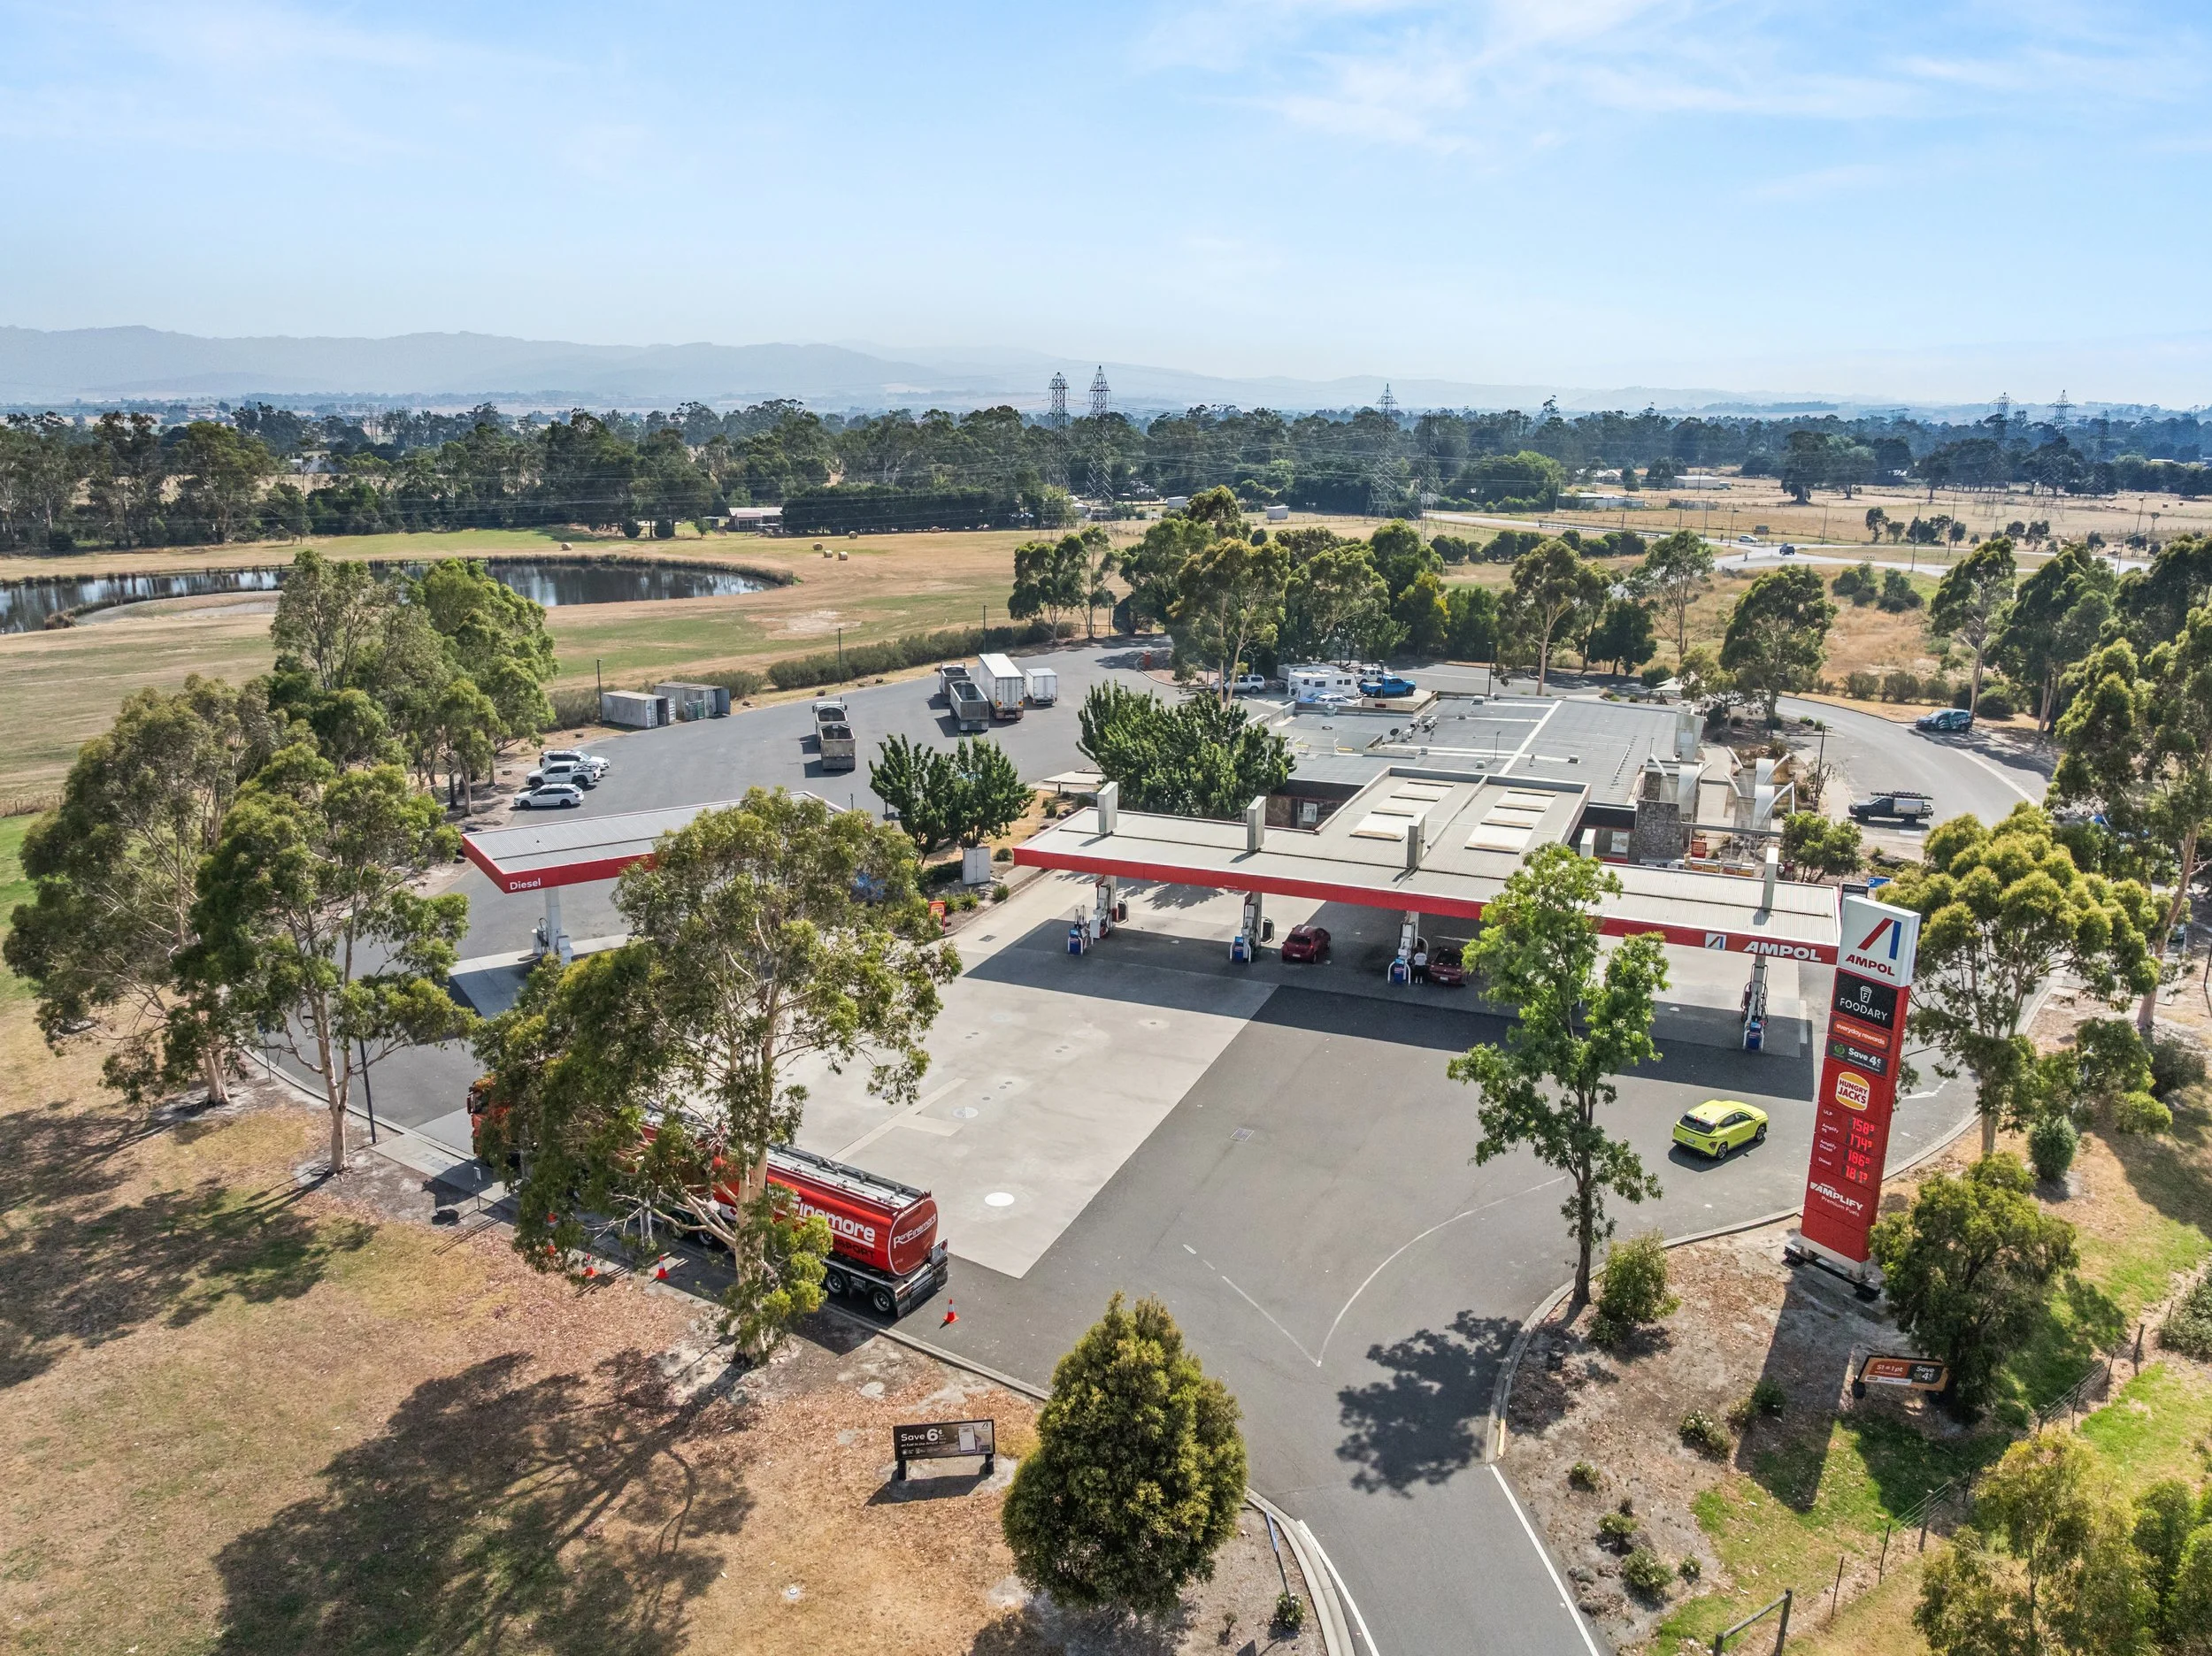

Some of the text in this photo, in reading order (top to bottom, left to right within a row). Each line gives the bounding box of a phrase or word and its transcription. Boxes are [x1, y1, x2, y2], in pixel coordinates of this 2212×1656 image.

[510, 878, 541, 891] Diesel
[1743, 941, 1822, 962] AMPOL
[1846, 954, 1895, 977] AMPOL
[1839, 997, 1888, 1021] FOODARY
[1836, 1024, 1886, 1046] everyday rewards
[1848, 1047, 1869, 1061] Save
[1839, 1078, 1868, 1095] HUNGRY
[1822, 1123, 1839, 1134] Amplify
[1820, 1139, 1837, 1150] Amplify
[1818, 1157, 1832, 1166] Diesel
[1815, 1184, 1863, 1211] AMPLIFY
[1821, 1195, 1860, 1217] Premium Fuels
[901, 1433, 926, 1442] Save
